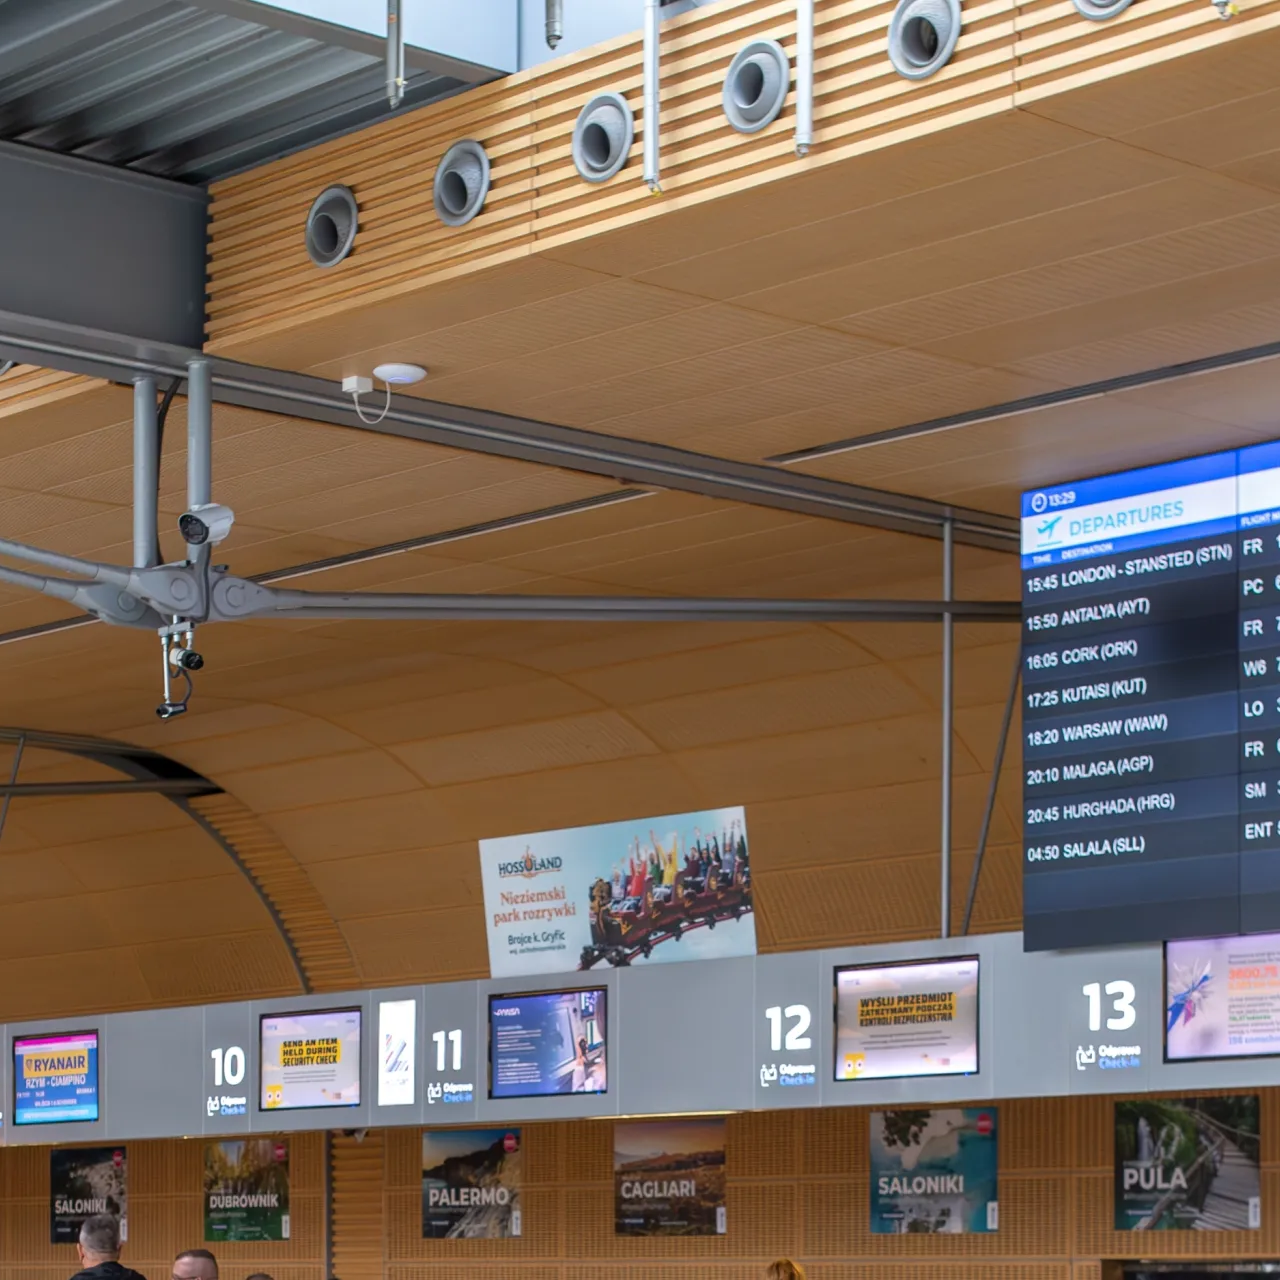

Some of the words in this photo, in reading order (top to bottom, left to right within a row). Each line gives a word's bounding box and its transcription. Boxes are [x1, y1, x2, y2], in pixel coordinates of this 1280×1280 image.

[1069, 501, 1184, 537] DEPARTURES
[1243, 538, 1263, 555] FR
[1027, 575, 1058, 592] 15:45
[1062, 565, 1115, 588] LONDON
[1125, 551, 1194, 577] STANSTED
[1195, 543, 1233, 567] (STN)
[1243, 578, 1264, 596] PC
[1027, 614, 1058, 631] 15:50
[1062, 603, 1116, 625] ANTALYA
[1117, 598, 1150, 618] (AYT)
[1243, 619, 1263, 637] FR
[1027, 653, 1058, 669] 16:05
[1062, 644, 1100, 664] CORK
[1101, 640, 1137, 658] (ORK)
[1244, 659, 1267, 677] W6
[1028, 691, 1058, 708] 17:25
[1062, 682, 1109, 703] KUTAISI
[1112, 678, 1147, 698] (KUT)
[1244, 701, 1264, 717] LO
[1028, 730, 1059, 746] 18:20
[1063, 720, 1122, 741] WARSAW
[1124, 714, 1168, 736] (WAW)
[1027, 769, 1059, 784] 20:10
[1063, 761, 1116, 780] MALAGA
[1117, 756, 1154, 774] (AGP)
[1028, 808, 1059, 823] 20:45
[1063, 799, 1136, 819] HURGHADA
[1137, 794, 1175, 814] (HRG)
[1245, 821, 1273, 839] ENT
[1028, 847, 1059, 861] 04:50
[1064, 841, 1111, 858] SALALA
[1113, 837, 1145, 854] (SLL)
[500, 886, 566, 905] Nieziemski
[494, 909, 521, 927] park
[523, 902, 576, 921] rozrywki
[897, 992, 952, 1005] PRZEDMIOT
[1082, 980, 1136, 1030] 13
[765, 1004, 811, 1050] 12
[283, 1040, 303, 1048] SEND
[306, 1046, 337, 1054] DURING
[432, 1030, 462, 1071] 11
[34, 1056, 85, 1073] RYANAIR
[211, 1047, 245, 1085] 10
[283, 1056, 314, 1067] SECURITY
[316, 1055, 337, 1064] CHECK
[26, 1077, 45, 1087] RZYM
[51, 1076, 86, 1087] CIAMPINO
[878, 1175, 964, 1195] SALONIKI
[1123, 1168, 1188, 1190] PULA
[429, 1187, 509, 1206] PALERMO
[621, 1180, 696, 1198] CAGLIARI
[54, 1199, 107, 1216] SALONIKI
[210, 1194, 279, 1209] DUBROWNIK
